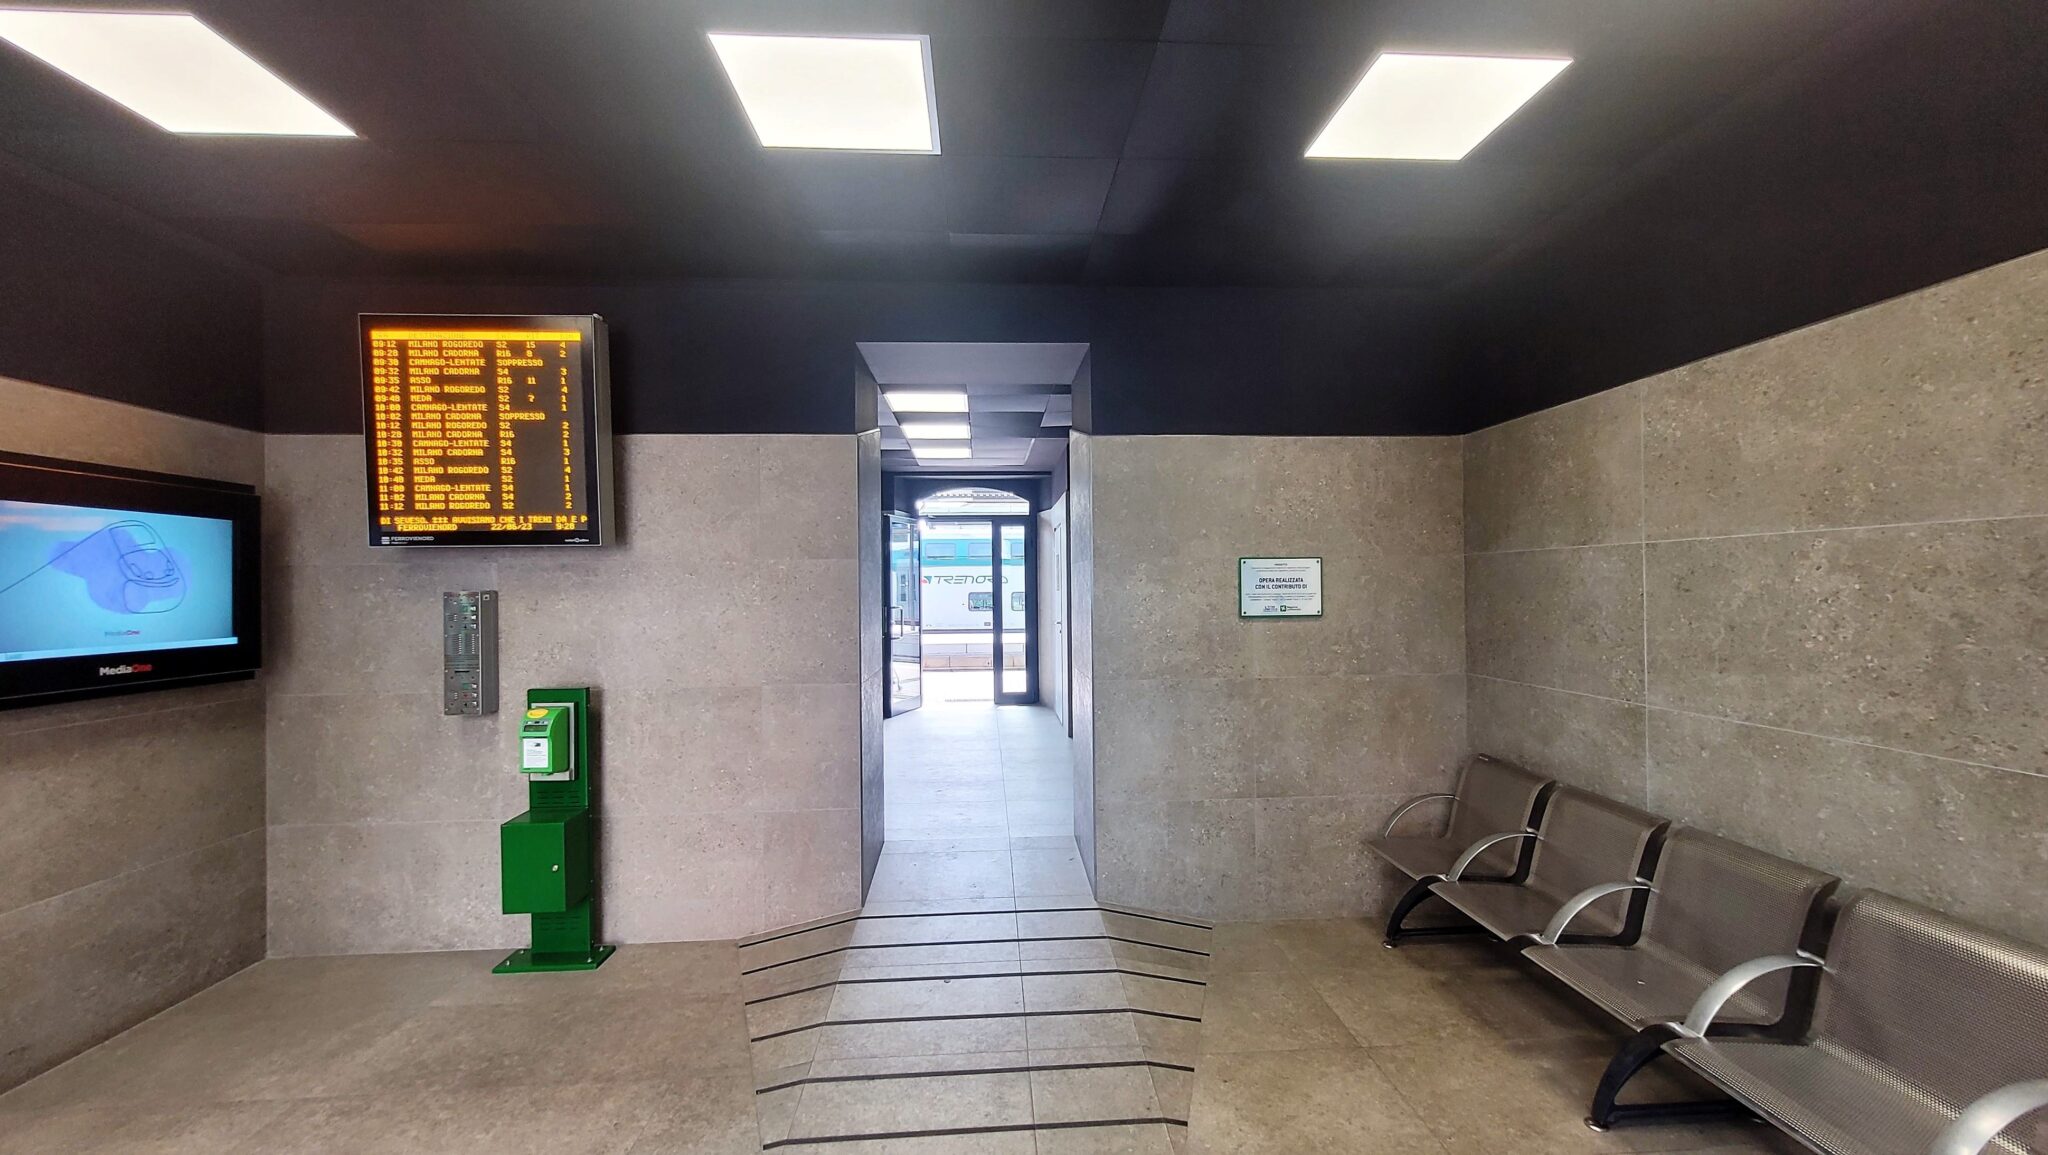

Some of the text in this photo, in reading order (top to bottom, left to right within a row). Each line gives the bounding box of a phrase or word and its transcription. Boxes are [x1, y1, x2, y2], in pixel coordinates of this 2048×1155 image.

[373, 340, 566, 348] 09:12 MILANO ROGOREDO S2 15 4
[374, 358, 543, 366] 09:30 CAMNAGO-LENTATE SOPPRESSO
[374, 376, 399, 384] 09:35
[410, 376, 431, 384] ASSO
[527, 376, 537, 384] 11
[560, 376, 566, 384] 1
[375, 394, 400, 402] 09:48
[411, 394, 432, 402] MEDA
[497, 394, 510, 402] S2
[561, 394, 567, 402] 1
[376, 412, 545, 420] 10:02 MILANO CADORNA SOPPRESSO
[377, 430, 402, 438] 10:28
[412, 430, 441, 438] MILANO
[446, 430, 482, 438] CADORNA
[562, 430, 570, 438] 2
[378, 448, 571, 456] 10:32 MILANO CADORNA S4 3
[379, 466, 571, 474] 10:42 MILANO ROGOREDO S2 4
[380, 484, 571, 492] 11:00 CAMNAGO-LENTATE S4 1
[380, 502, 573, 510] 11:12 MILANO ROGOREDO S2 2
[100, 664, 152, 676] MediaOne
